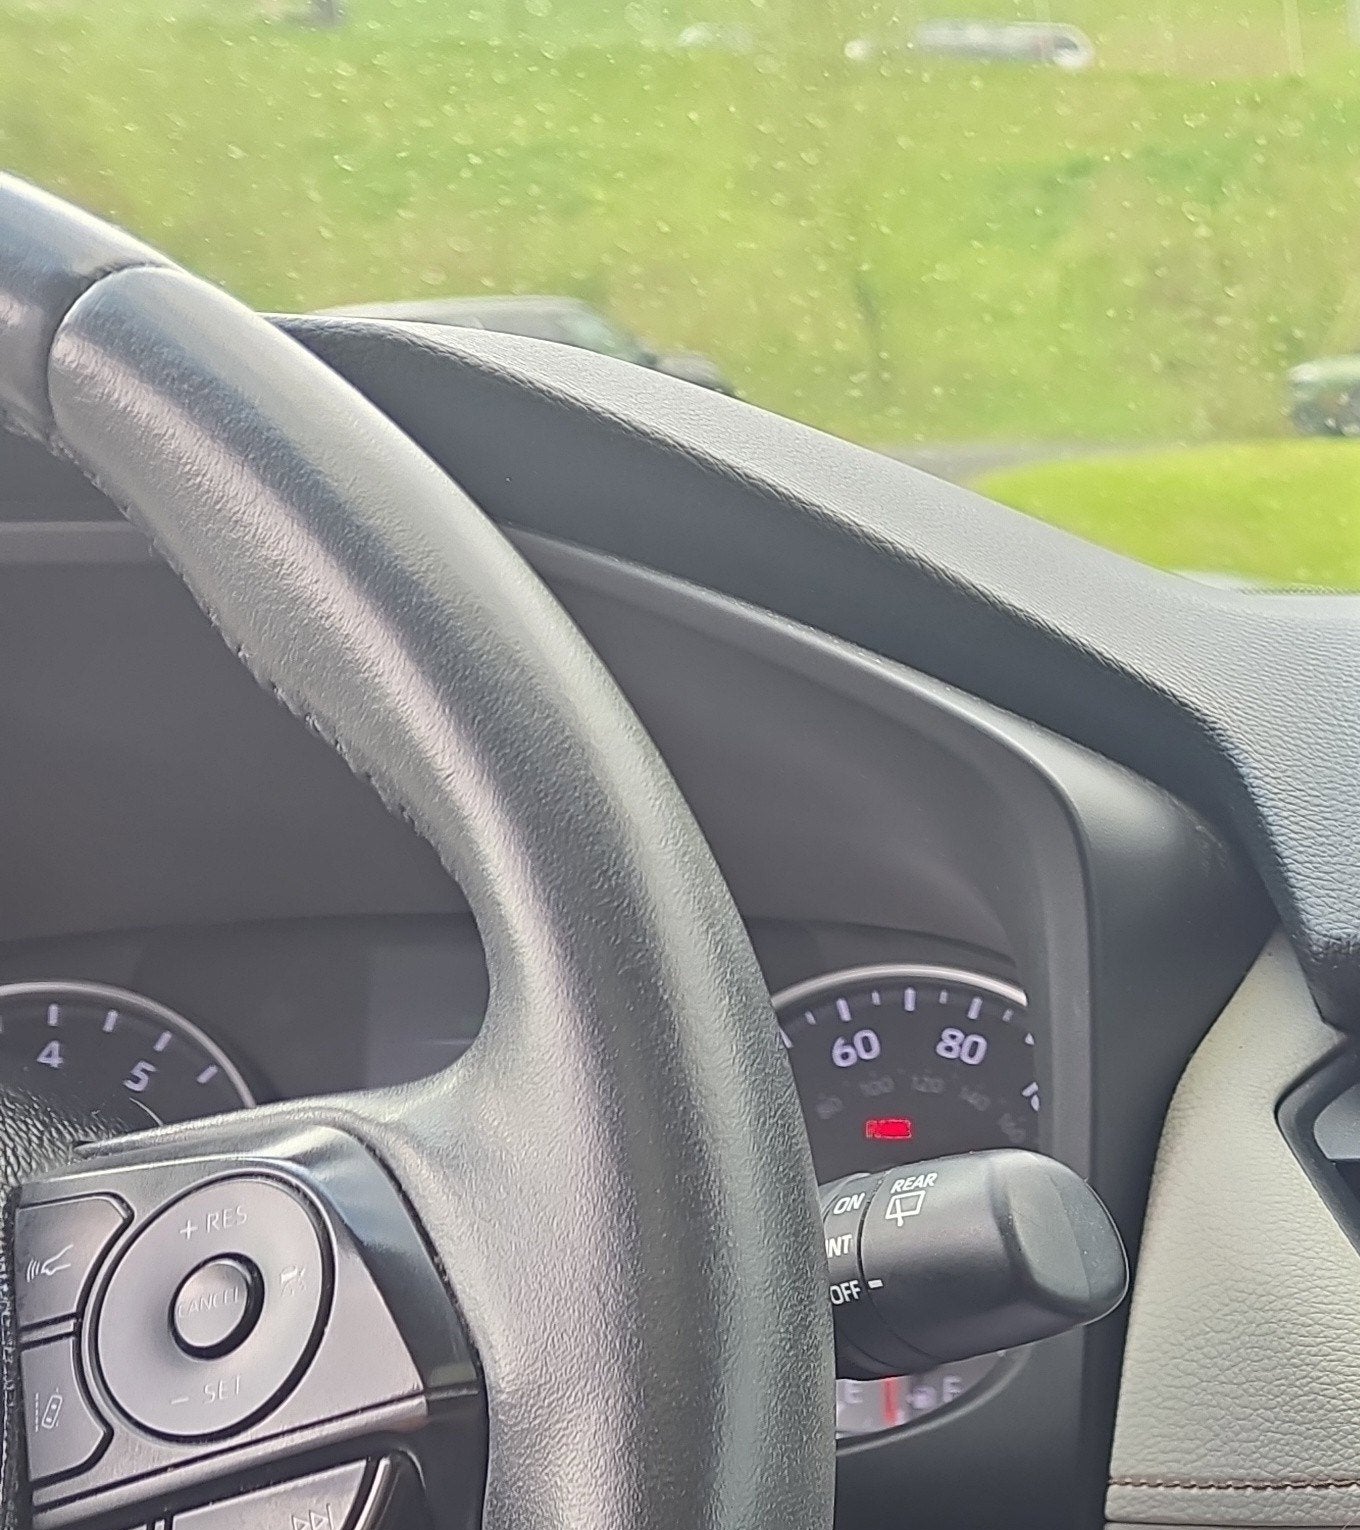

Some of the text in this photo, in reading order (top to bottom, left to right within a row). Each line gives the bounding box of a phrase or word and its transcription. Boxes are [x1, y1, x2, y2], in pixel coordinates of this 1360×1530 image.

[36, 1040, 64, 1068] 4
[831, 1029, 881, 1068] 60
[936, 1028, 987, 1065] 80
[123, 1061, 157, 1092] 5
[890, 1172, 938, 1194] REAR
[833, 1192, 865, 1215] ON
[205, 1206, 248, 1234] RES
[829, 1280, 861, 1305] OFF
